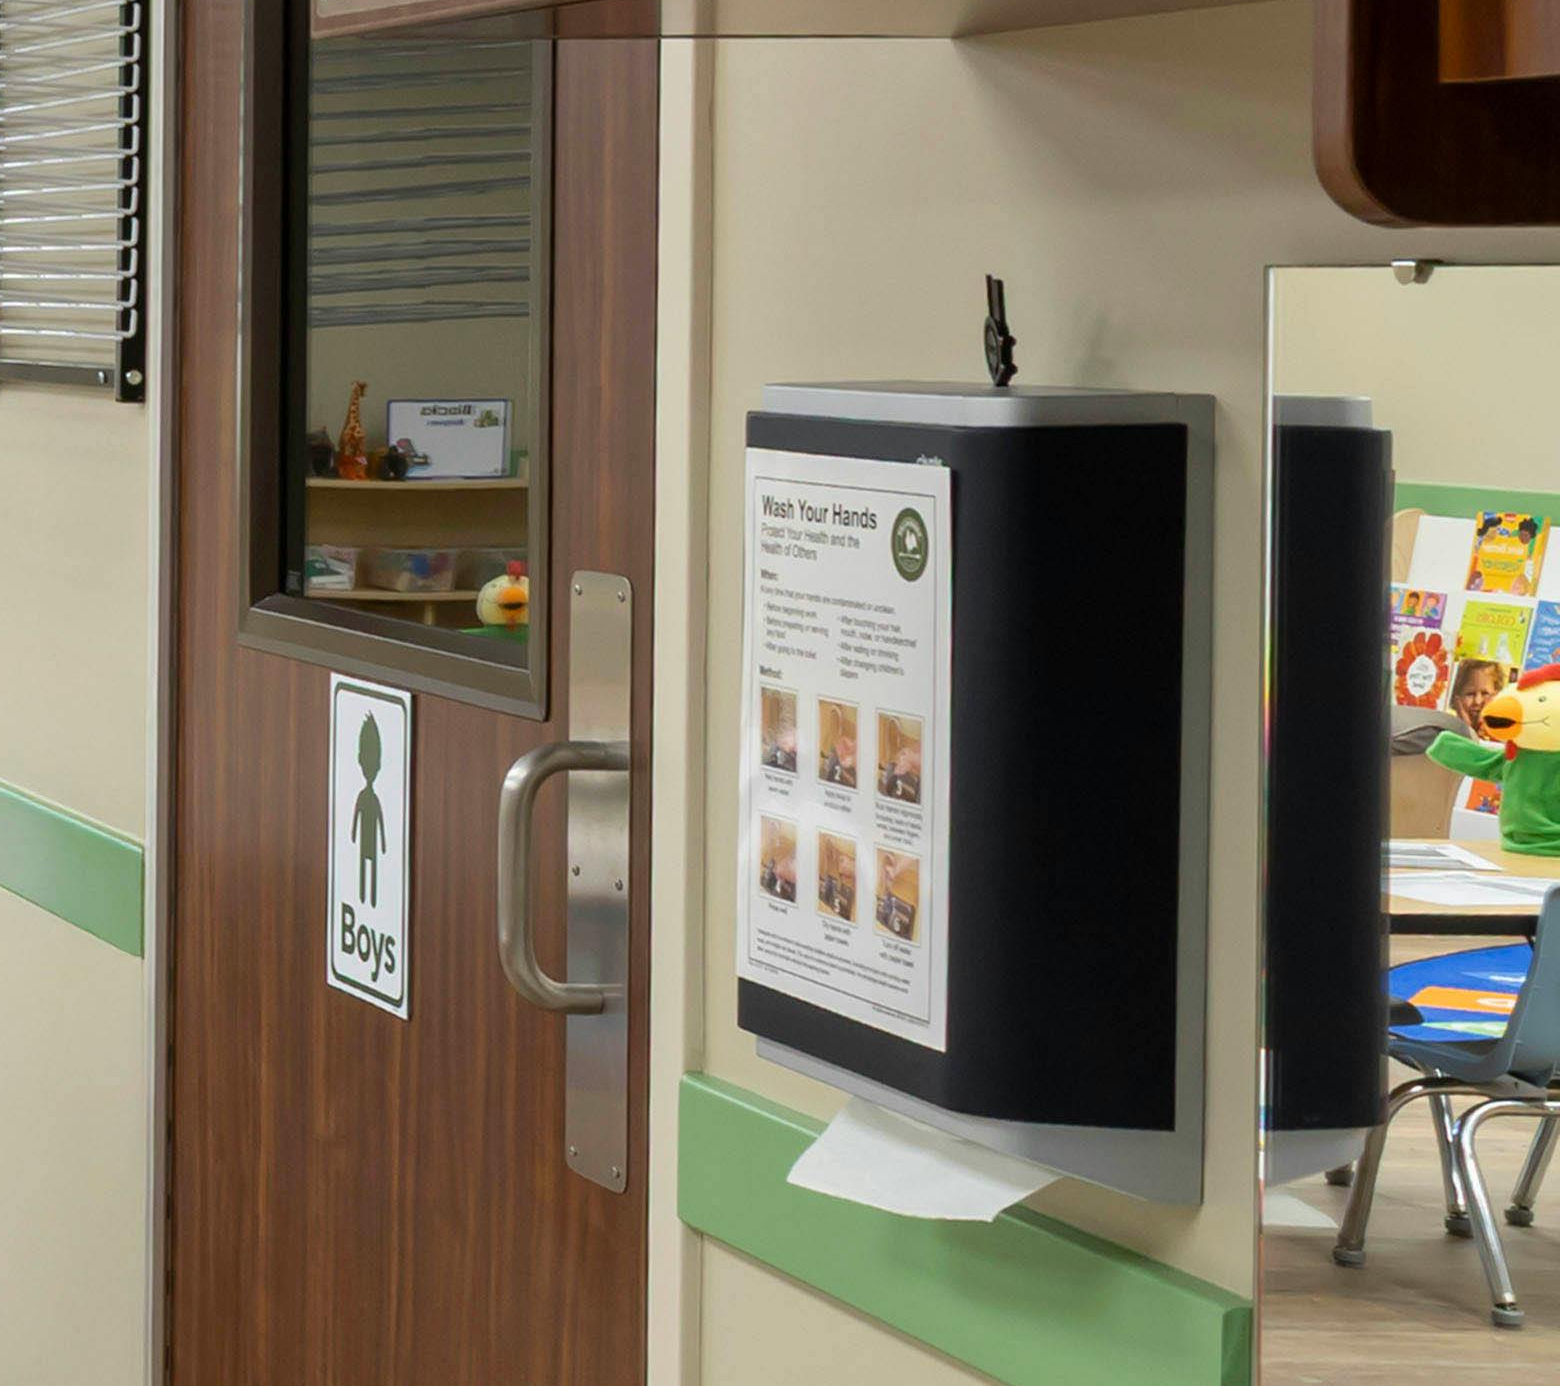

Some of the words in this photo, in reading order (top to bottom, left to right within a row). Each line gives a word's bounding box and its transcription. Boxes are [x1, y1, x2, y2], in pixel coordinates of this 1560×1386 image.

[762, 495, 794, 519] Wash
[798, 499, 828, 522] Your
[832, 503, 878, 530] Hands
[341, 901, 396, 983] Boys
